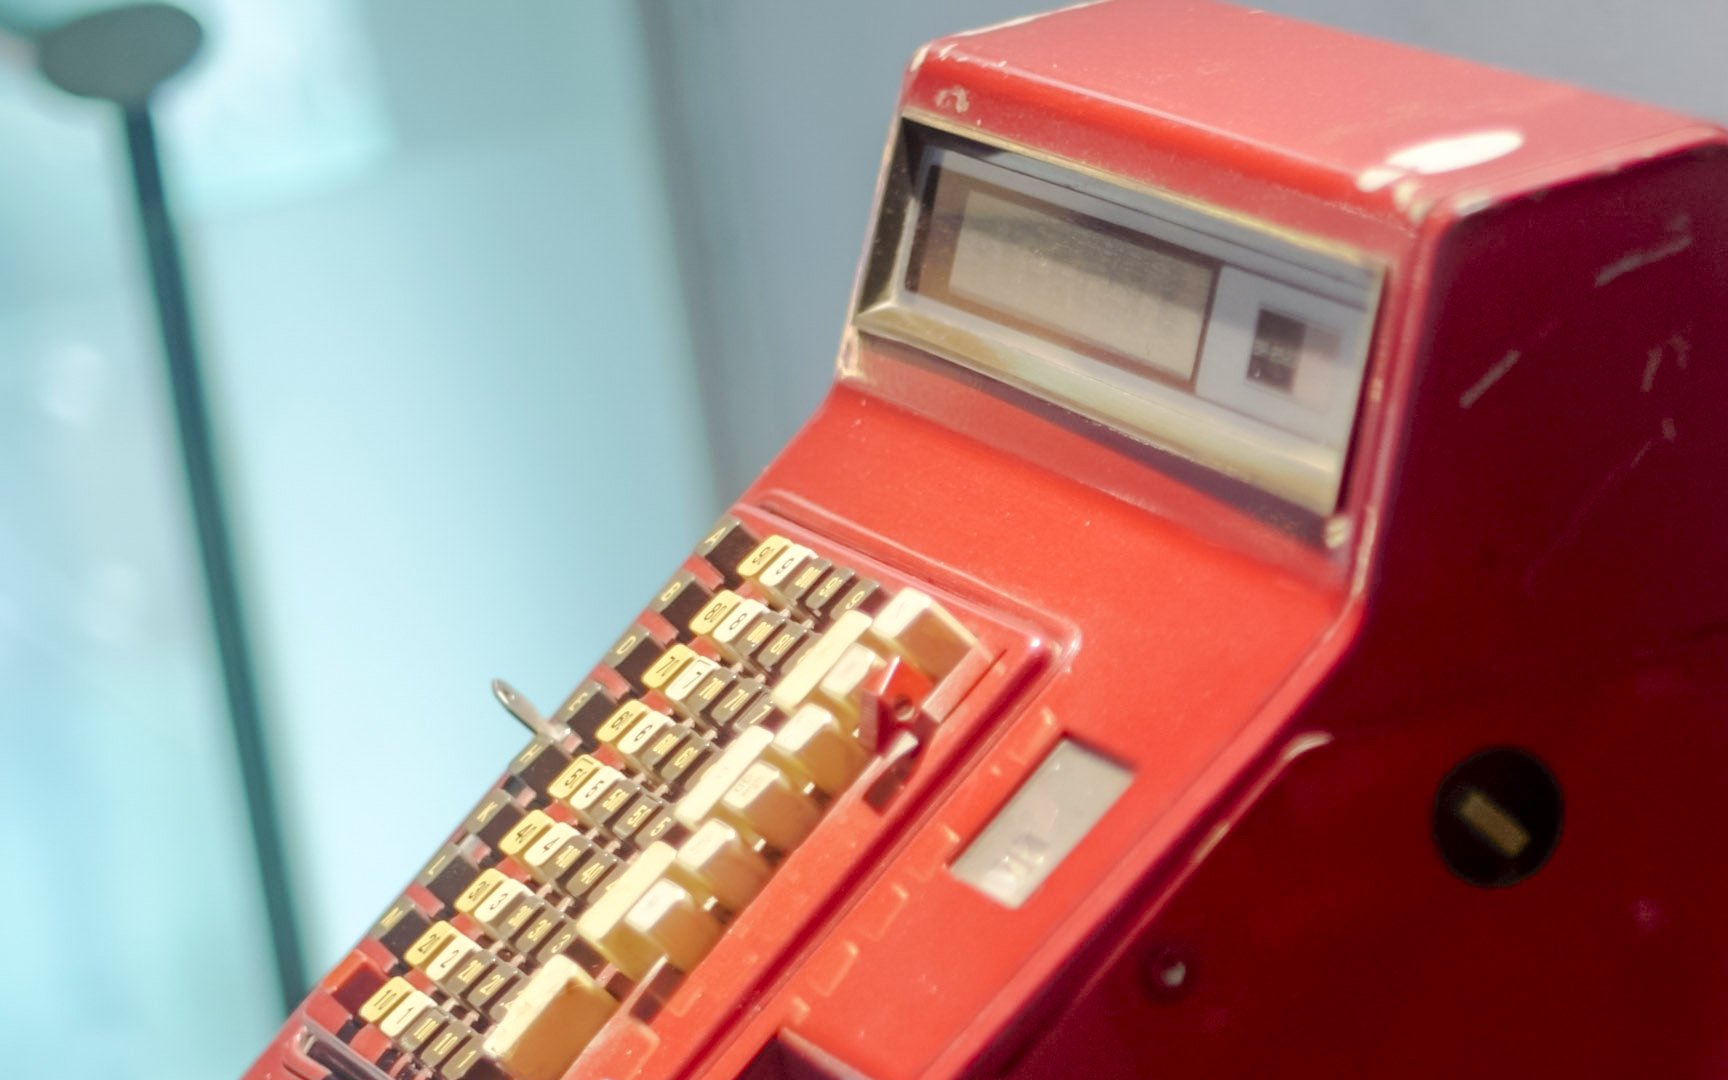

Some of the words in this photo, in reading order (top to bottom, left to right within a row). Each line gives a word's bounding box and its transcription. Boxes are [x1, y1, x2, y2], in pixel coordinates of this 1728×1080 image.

[705, 526, 726, 545] A
[775, 558, 794, 575] 9
[845, 591, 865, 610] 9
[660, 583, 680, 601] B
[728, 613, 747, 631] 8
[616, 636, 636, 654] D
[683, 672, 702, 690] 7
[749, 705, 771, 726] 7
[633, 723, 653, 742] 6
[476, 802, 498, 822] K
[541, 834, 561, 852] 4
[585, 780, 604, 798] 5
[649, 817, 671, 837] 5
[489, 893, 507, 910] 3
[550, 934, 571, 953] 3
[439, 949, 459, 968] 2
[396, 1008, 412, 1024] 1
[458, 1050, 477, 1069] 1
